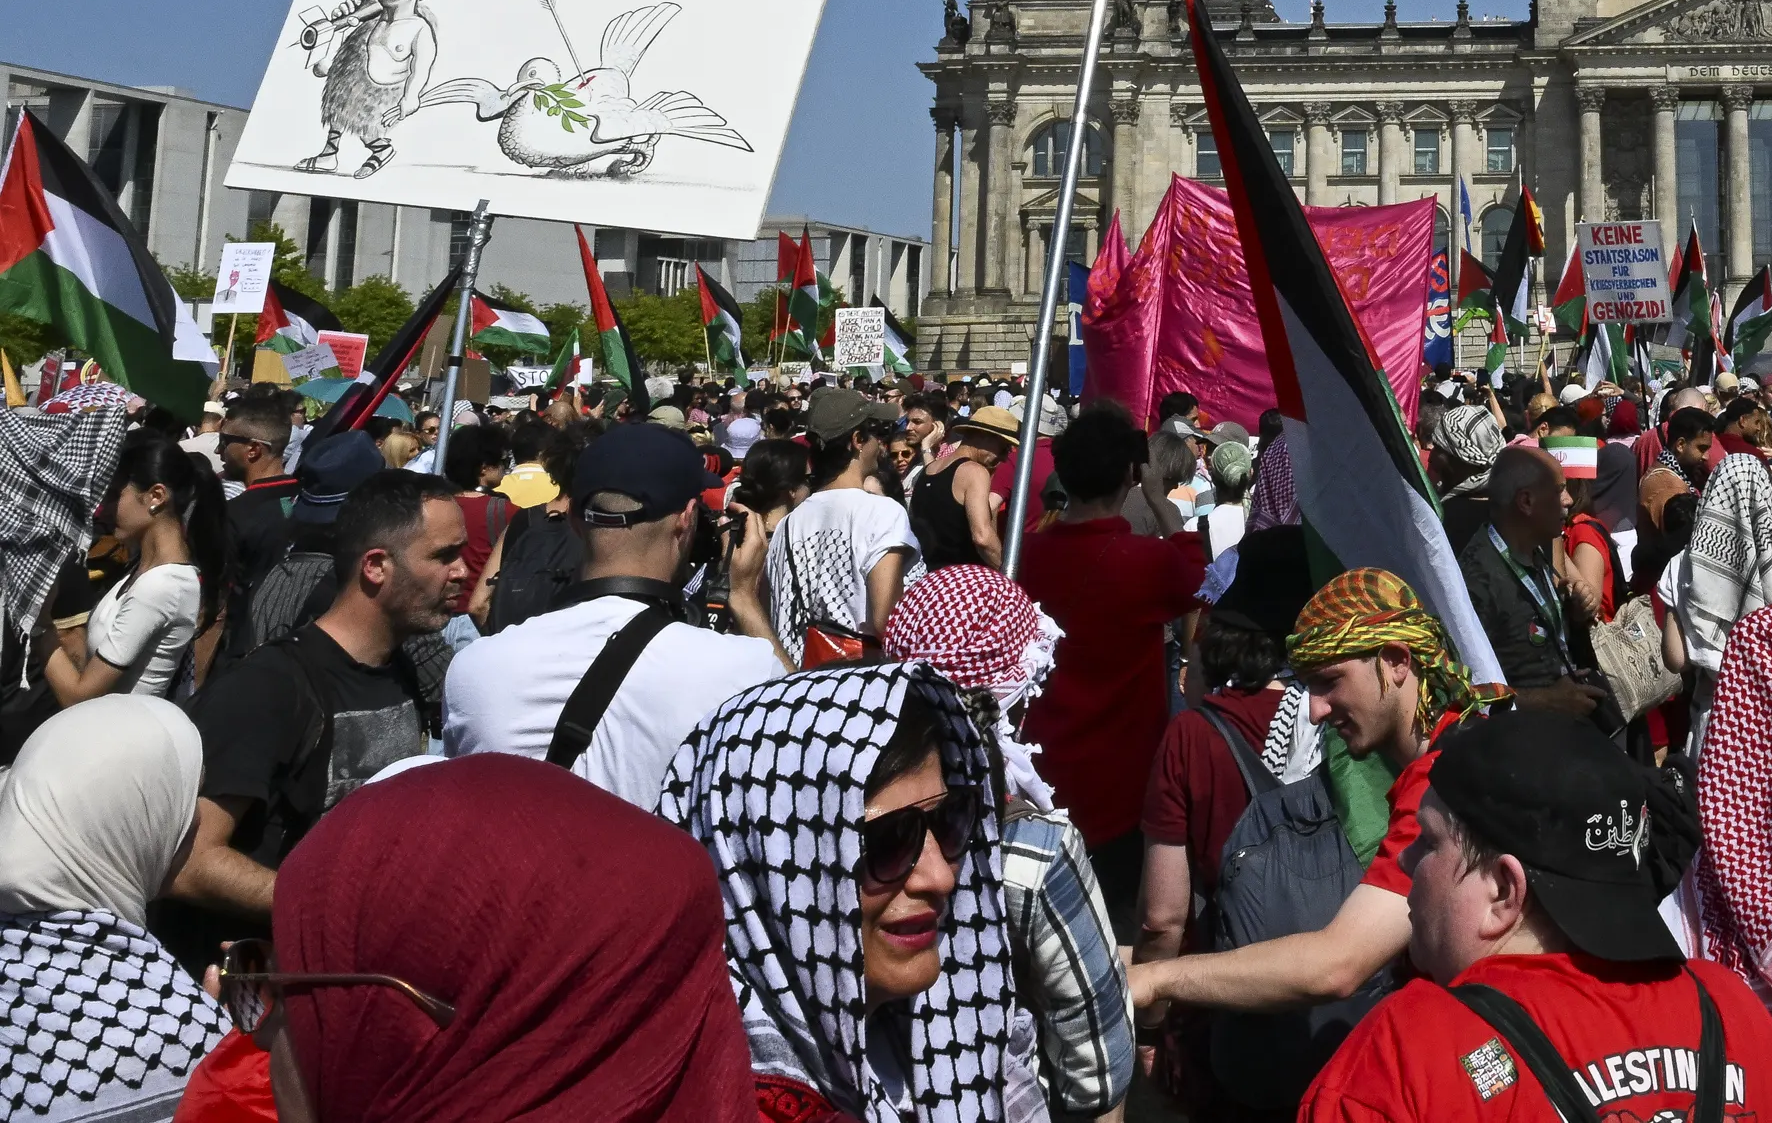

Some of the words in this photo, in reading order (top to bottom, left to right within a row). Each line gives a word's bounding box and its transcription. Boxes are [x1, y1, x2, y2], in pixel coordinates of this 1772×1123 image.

[1689, 67, 1720, 77] DEM
[1591, 225, 1644, 246] KEINE
[1585, 247, 1659, 265] STAATSRÄSON
[1590, 278, 1657, 291] KRIEGSVERBRECHEN
[1617, 291, 1636, 301] UND
[1592, 299, 1666, 321] GENOZID!
[518, 370, 548, 386] STO
[1492, 1060, 1514, 1086] FREE
